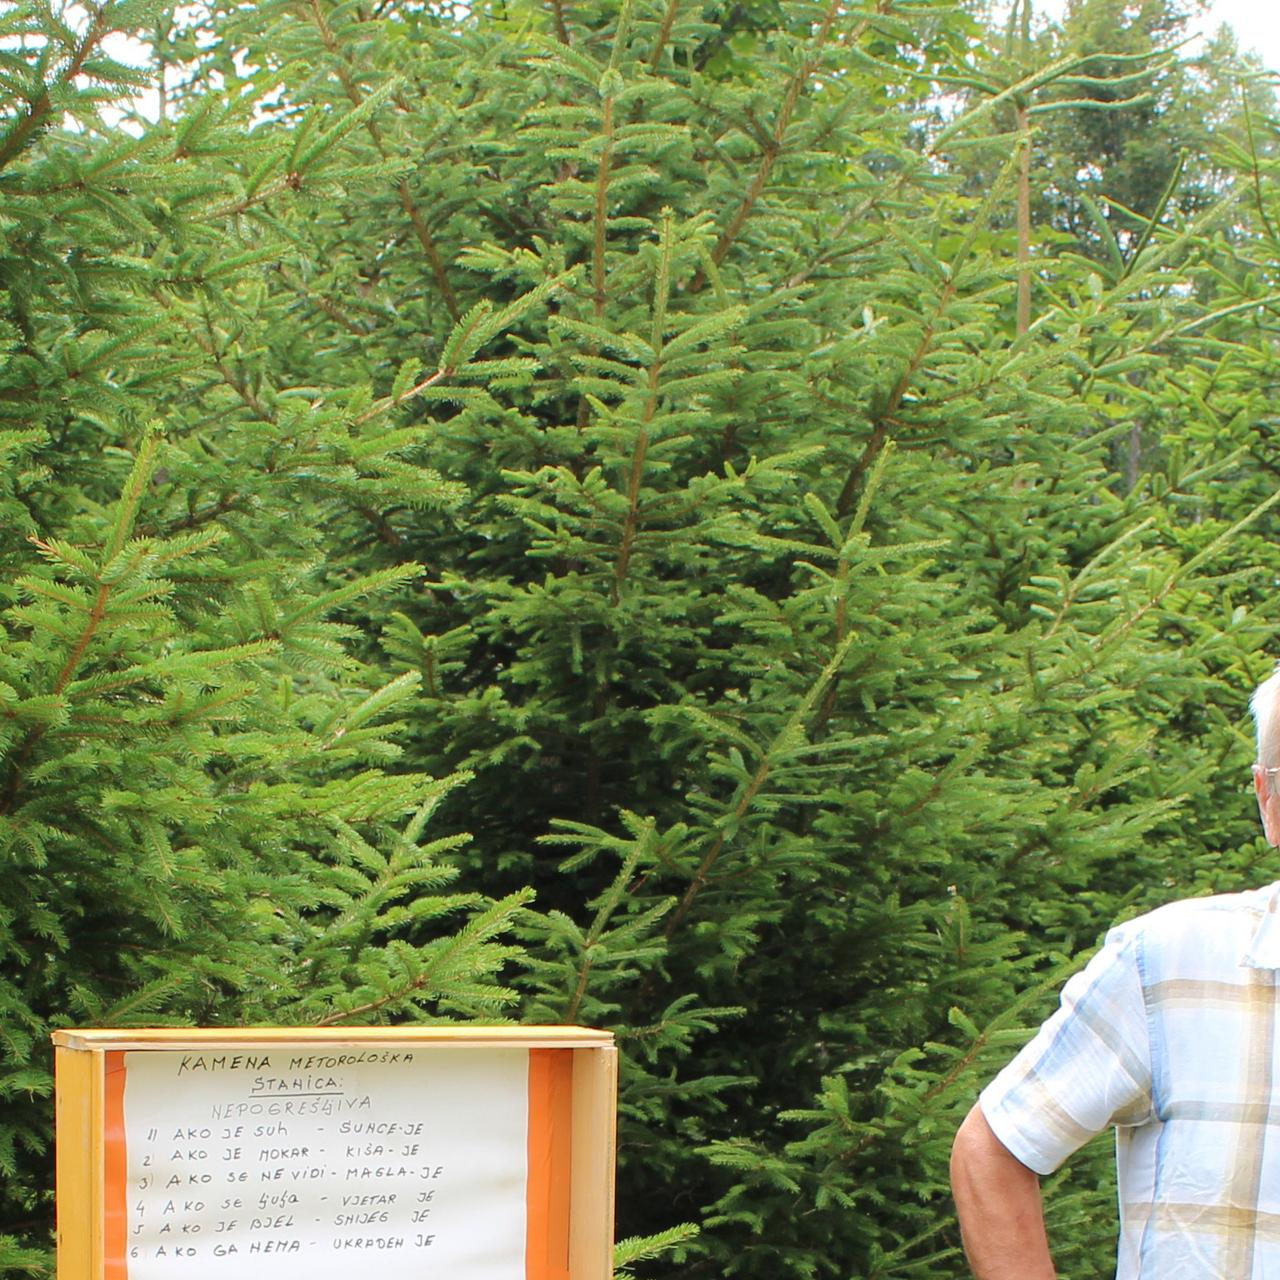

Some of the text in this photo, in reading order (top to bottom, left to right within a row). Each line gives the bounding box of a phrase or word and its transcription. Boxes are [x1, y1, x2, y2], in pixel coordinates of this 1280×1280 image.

[177, 1050, 414, 1076] KAMENA METOROLOŠKA
[173, 1128, 212, 1141] AKO
[221, 1126, 244, 1140] JE
[171, 1149, 208, 1161] AKO
[222, 1147, 243, 1161] JE
[165, 1174, 212, 1189] AKO
[226, 1172, 249, 1183] SE
[261, 1168, 285, 1182] NE
[163, 1200, 206, 1215] AKO
[221, 1198, 243, 1209] SE
[342, 1194, 397, 1207] VJETAR
[417, 1190, 436, 1203] JE
[132, 1224, 144, 1235] 5
[160, 1223, 201, 1234] AKO
[215, 1220, 238, 1232] JE
[250, 1215, 294, 1230] BJEL
[411, 1209, 431, 1223] JE
[130, 1247, 139, 1258] 6
[155, 1245, 197, 1258] AKO
[213, 1244, 238, 1257] GA
[333, 1237, 404, 1250] UKRADEN
[415, 1234, 436, 1247] JE
